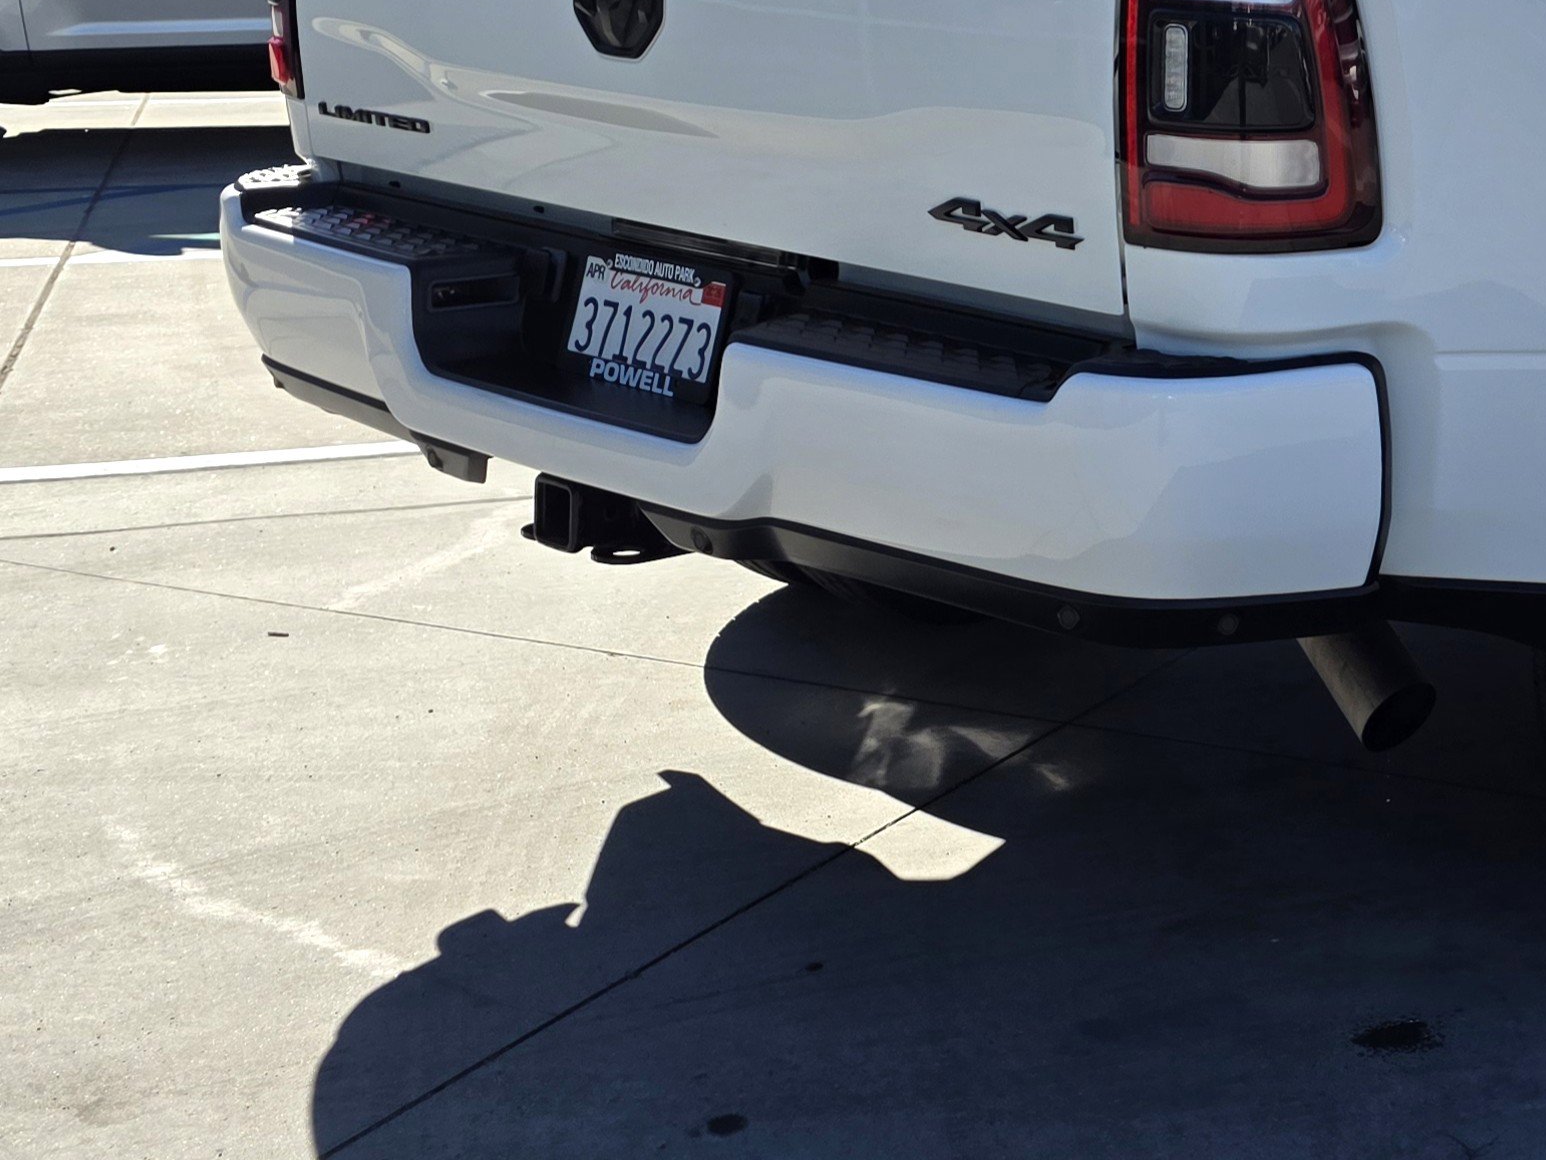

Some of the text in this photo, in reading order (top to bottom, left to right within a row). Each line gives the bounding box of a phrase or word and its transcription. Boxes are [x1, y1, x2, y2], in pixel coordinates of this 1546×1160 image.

[318, 101, 430, 133] LIMITED
[586, 262, 607, 281] APR
[614, 253, 696, 283] ESCONDIDO AUTO PARK
[610, 270, 702, 306] California
[574, 296, 712, 381] 3712273
[589, 358, 674, 397] POWELL
